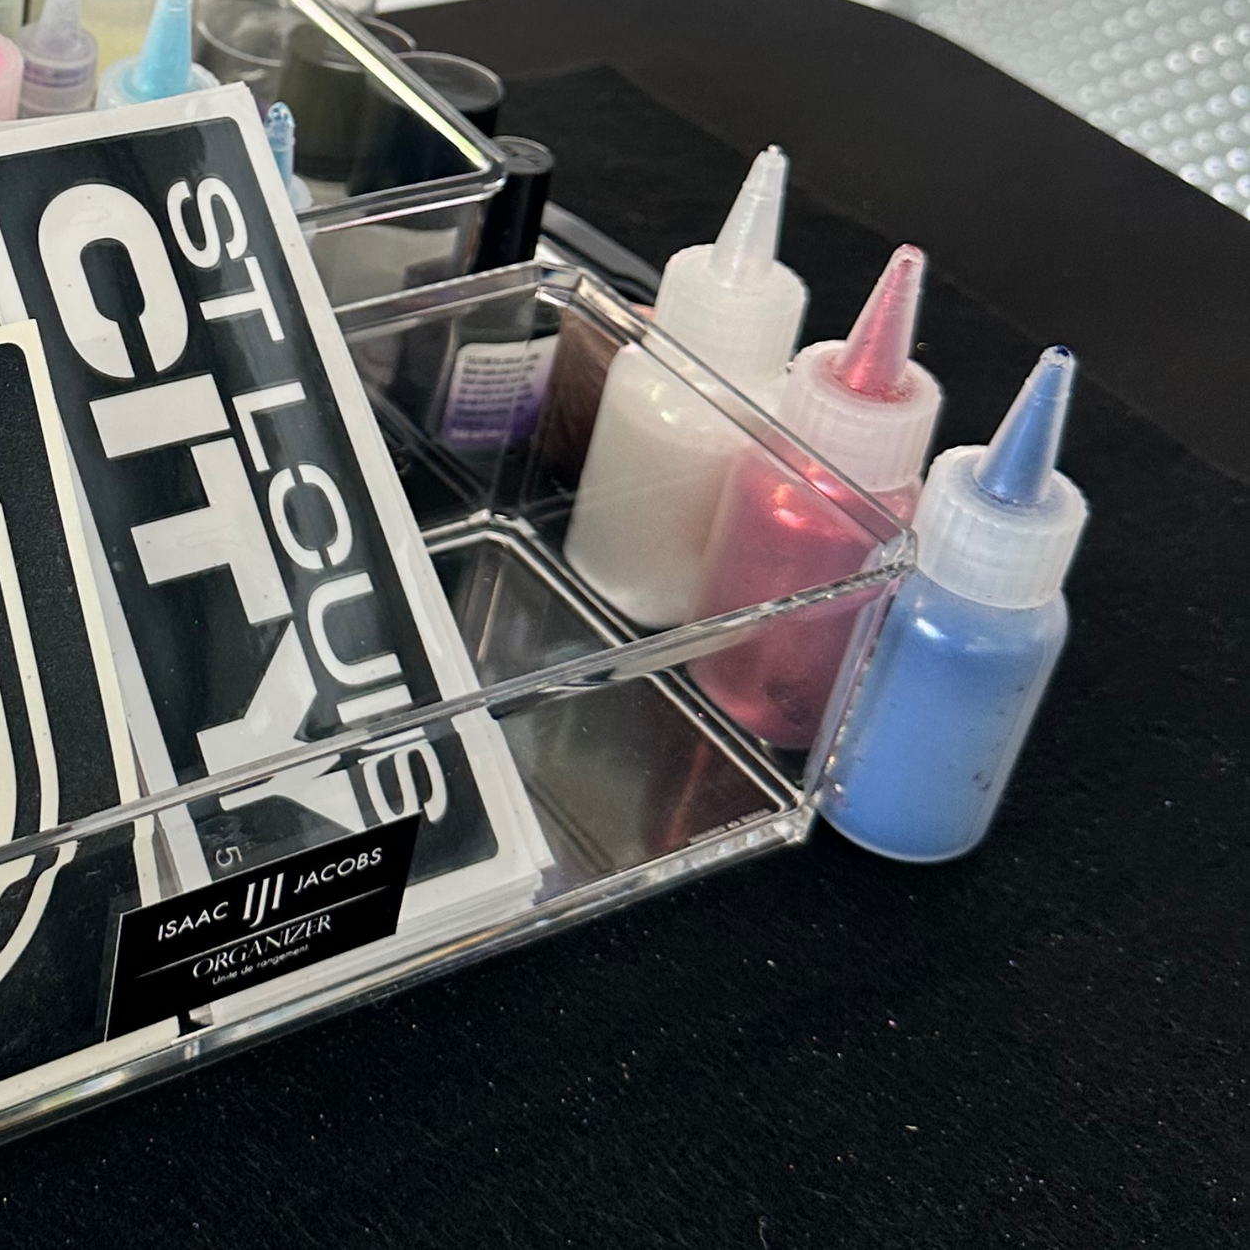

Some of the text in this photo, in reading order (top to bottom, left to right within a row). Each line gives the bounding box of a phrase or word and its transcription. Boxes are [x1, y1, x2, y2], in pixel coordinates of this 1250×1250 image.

[37, 183, 367, 834] CITY
[167, 178, 448, 825] ST LOUIS
[157, 901, 229, 942] ISAAC
[293, 847, 383, 894] JACOBS
[192, 914, 332, 978] ORGANIZER
